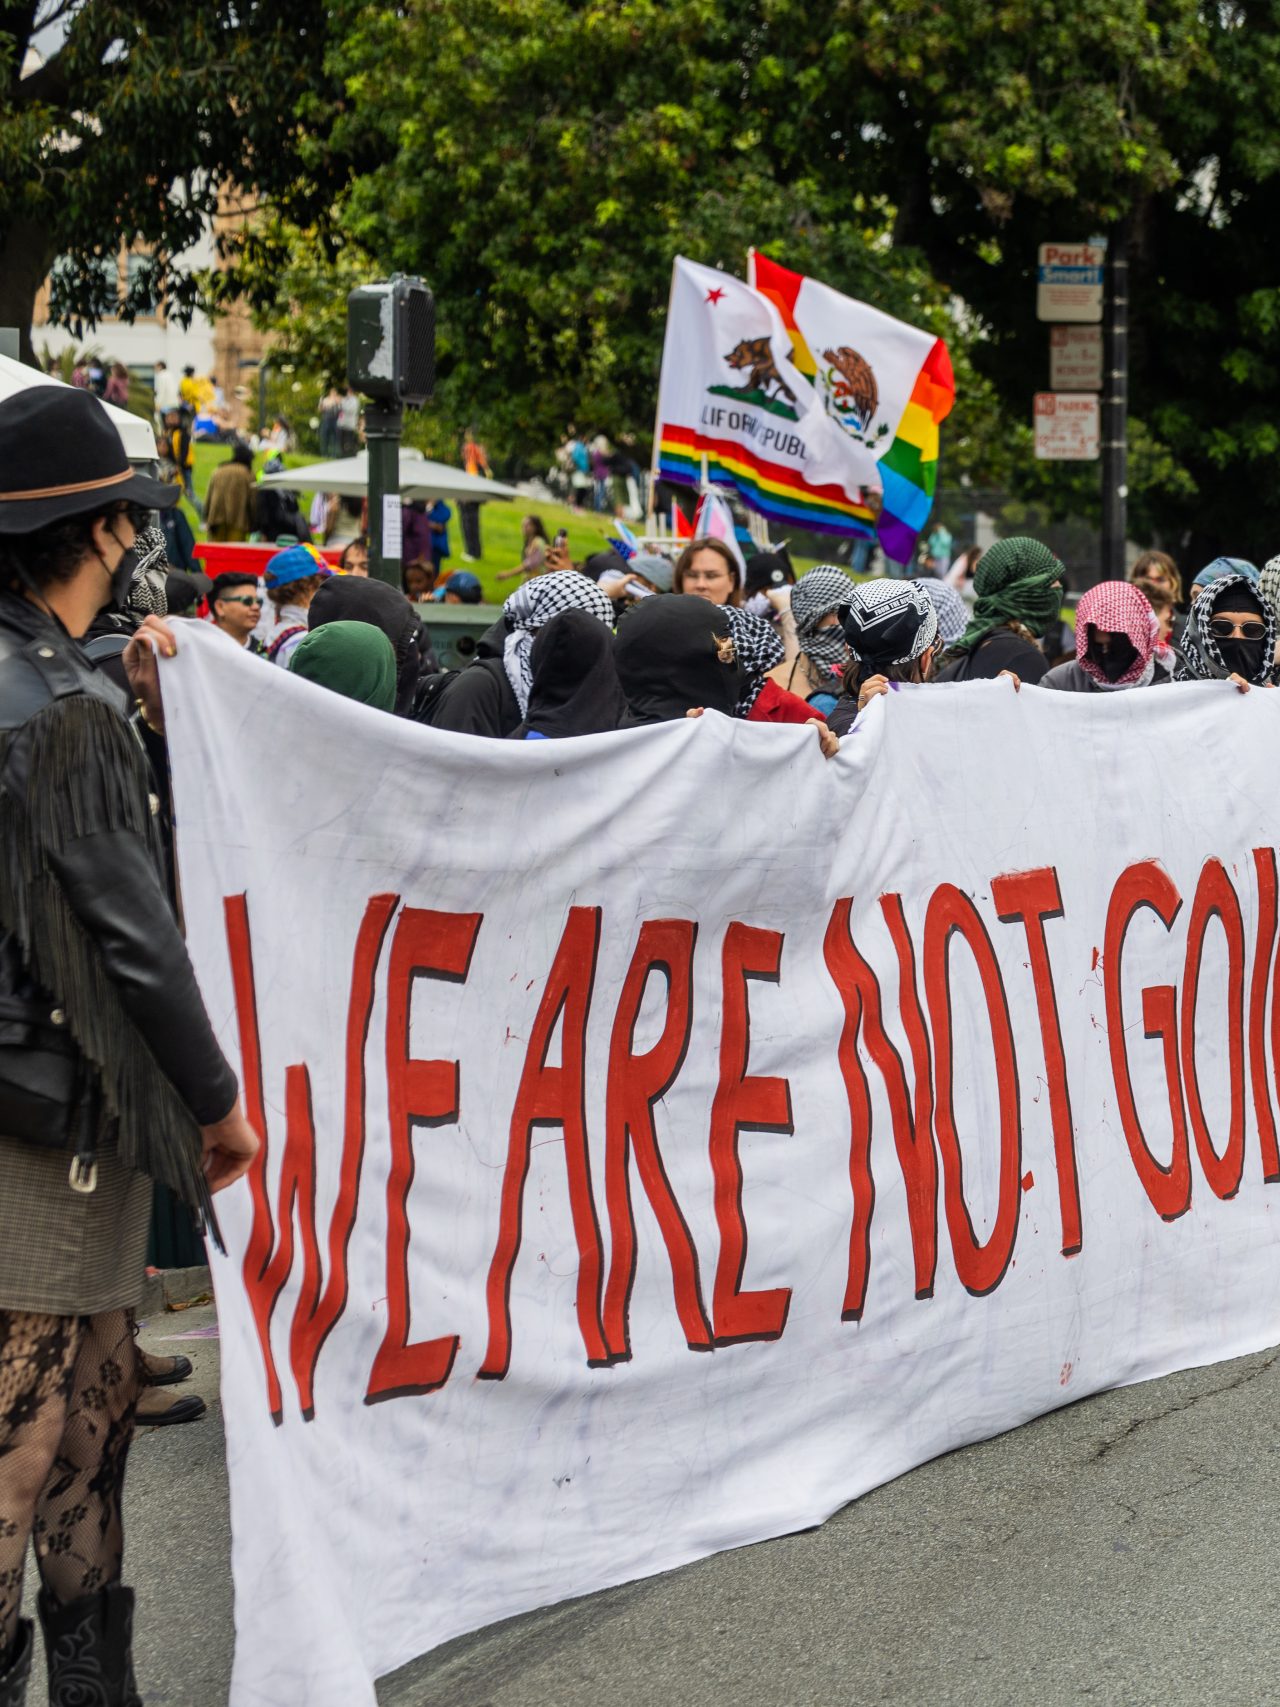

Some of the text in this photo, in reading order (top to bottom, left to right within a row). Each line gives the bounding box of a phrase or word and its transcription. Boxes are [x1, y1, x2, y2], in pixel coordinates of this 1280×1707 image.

[1045, 244, 1096, 266] Park
[889, 599, 900, 609] THE
[223, 890, 484, 1427] WE
[476, 906, 795, 1380] ARE
[822, 867, 1083, 1322] NOT
